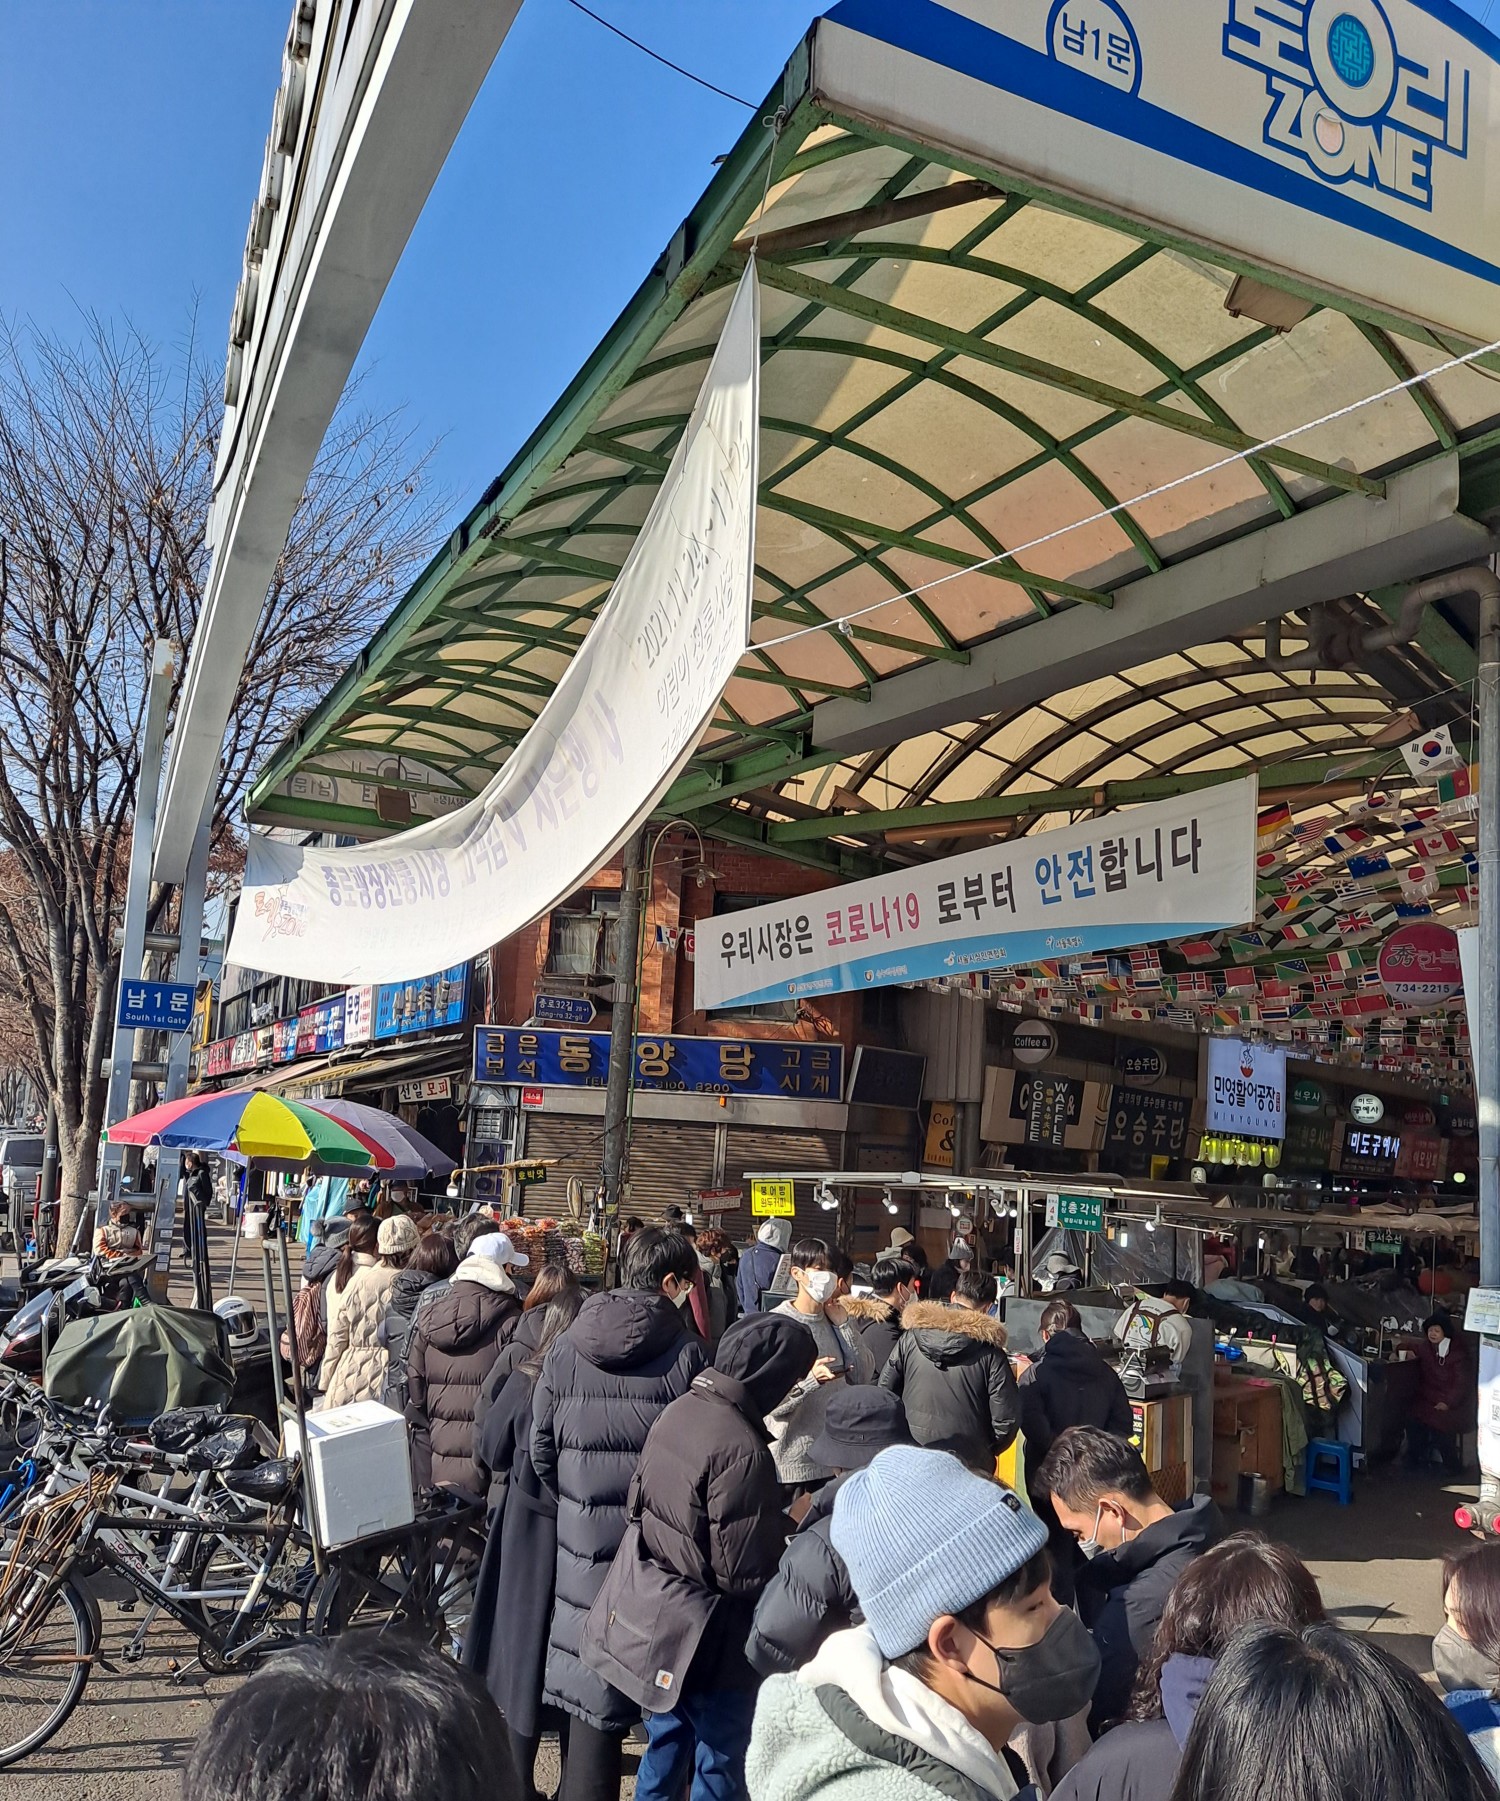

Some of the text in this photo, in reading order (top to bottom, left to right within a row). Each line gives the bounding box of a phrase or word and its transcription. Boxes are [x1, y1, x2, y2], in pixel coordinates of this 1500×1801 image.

[1063, 12, 1131, 75] 남1문
[1263, 75, 1433, 213] ZONE
[720, 818, 1202, 969] 우리시장은 코로나19 로부터 안전합니다
[1395, 983, 1450, 993] 734-2215
[539, 998, 573, 1011] 종로32길
[125, 1012, 187, 1025] South 1st Gate
[538, 1010, 583, 1021] Jong-ro 32-gil
[1015, 1037, 1040, 1047] Coffee
[1126, 1058, 1159, 1071] 오승주단
[400, 1079, 449, 1100] 선일 모피
[1214, 1075, 1276, 1113] 민영활어공장
[1029, 1080, 1044, 1142] COFFEE
[1052, 1082, 1069, 1145] WAFFLE
[1213, 1111, 1277, 1129] MINYOUNG
[1111, 1110, 1185, 1149] 오승주단
[1050, 1206, 1055, 1214] 4
[1068, 1201, 1101, 1217] 총각네
